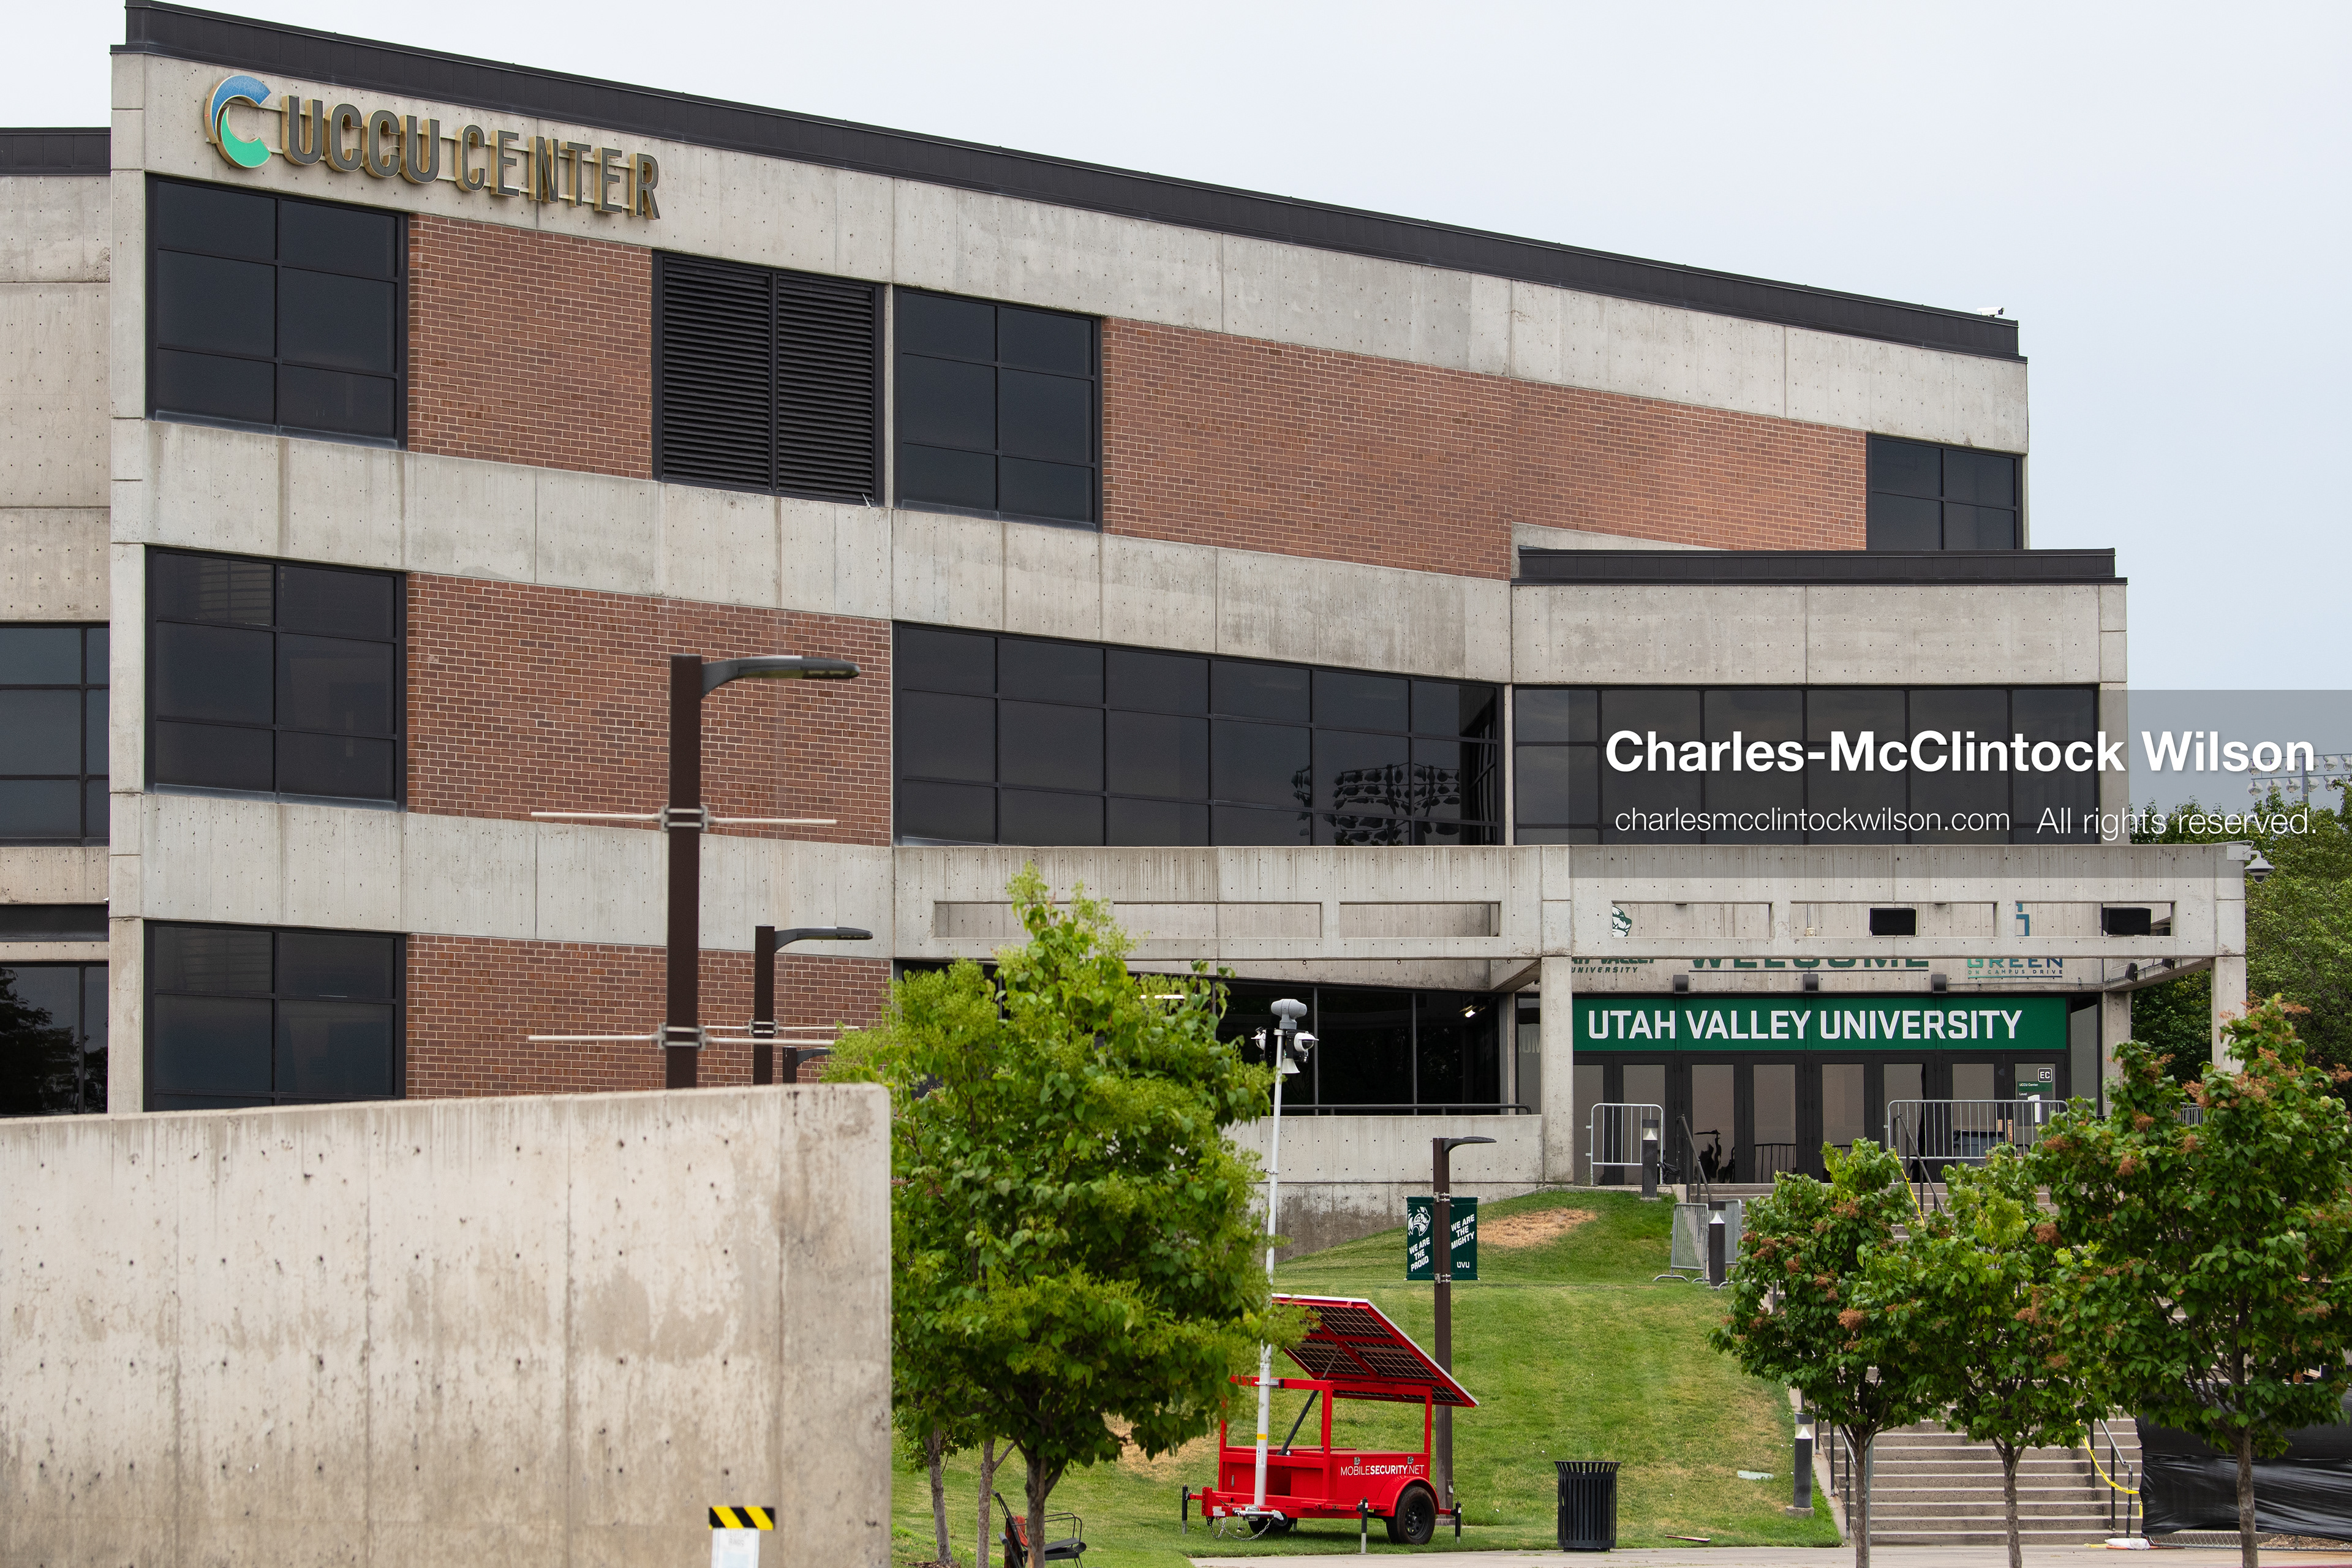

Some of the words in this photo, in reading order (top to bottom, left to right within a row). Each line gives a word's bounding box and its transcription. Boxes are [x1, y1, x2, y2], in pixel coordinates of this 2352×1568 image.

[281, 95, 440, 184] UCCU
[455, 124, 660, 220] CENTER
[1588, 1010, 1676, 1039] UTAH
[1685, 1010, 1812, 1039] VALLEY
[1820, 1010, 2022, 1039] UNIVERSITY
[2027, 1095, 2040, 1123] 1
[1450, 1221, 1461, 1232] WE
[1462, 1214, 1475, 1229] ARE
[1455, 1225, 1469, 1238] THE
[1409, 1243, 1418, 1254] WE
[1419, 1237, 1431, 1248] ARE
[1450, 1231, 1475, 1250] MIGHTY
[1414, 1248, 1425, 1261] THE
[1411, 1255, 1430, 1272] PROUD
[1340, 1464, 1425, 1476] MOBILESECURITY.NET
